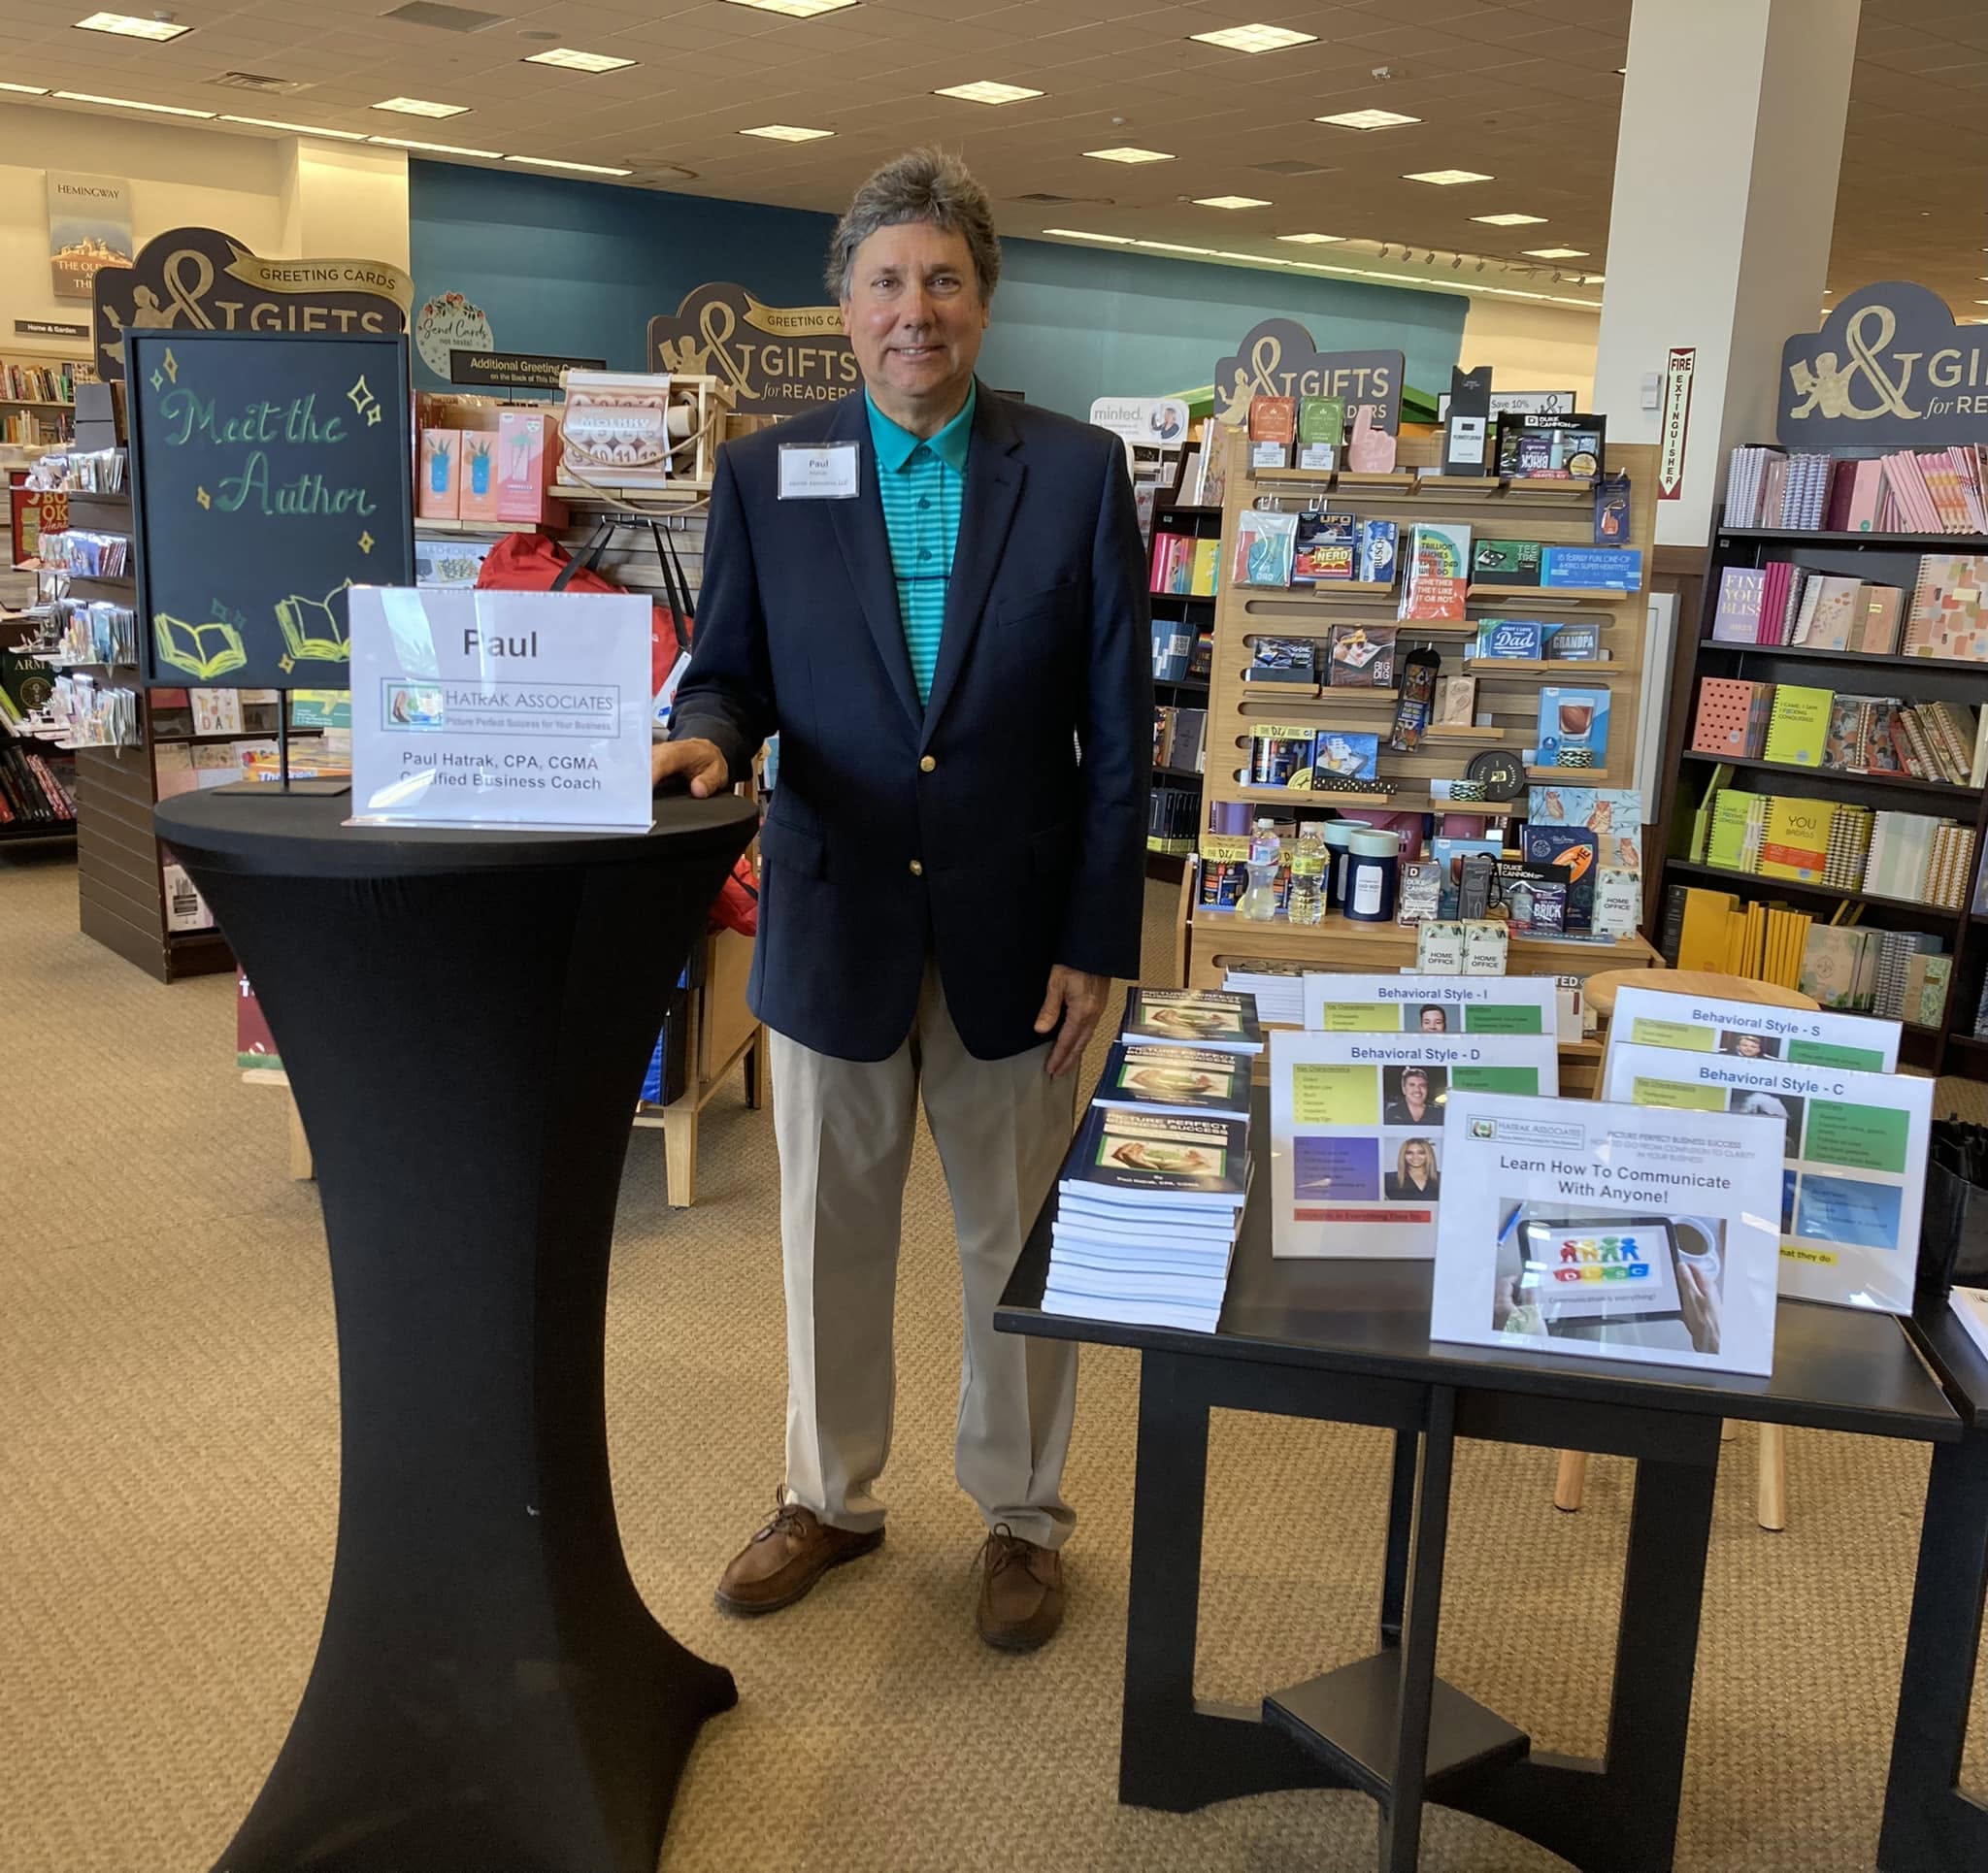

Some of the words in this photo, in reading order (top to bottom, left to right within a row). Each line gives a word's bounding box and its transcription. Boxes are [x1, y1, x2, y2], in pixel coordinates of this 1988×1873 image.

[57, 184, 119, 199] HEMINGWAY
[58, 260, 78, 271] THE
[260, 268, 339, 281] GREETING
[344, 270, 396, 290] CARDS
[423, 318, 452, 340] Send
[455, 319, 488, 340] Cards
[768, 315, 823, 327] GREETING
[471, 357, 517, 373] Additional
[520, 361, 560, 375] Greeting
[760, 345, 857, 381] GIFTS
[1671, 358, 1691, 372] FIRE
[761, 382, 779, 400] for
[1300, 368, 1390, 399] GIFTS
[1491, 401, 1509, 411] Save
[1923, 396, 1954, 419] for
[160, 389, 279, 444] Meet
[284, 392, 348, 443] the
[1665, 375, 1684, 484] EXTINGUISHER
[809, 459, 829, 468] Paul
[215, 446, 378, 516] Author
[1320, 515, 1350, 524] UFO
[1316, 551, 1349, 563] NERD
[1374, 537, 1384, 569] BUSCH
[464, 629, 537, 658] Paul
[1494, 632, 1535, 647] Dad
[1554, 636, 1595, 648] GRANDPA
[1374, 661, 1391, 671] BIG
[1373, 671, 1390, 679] DIG
[447, 691, 510, 706] HATRAK
[514, 693, 613, 710] ASSOCIATES
[403, 751, 437, 765] Paul
[443, 753, 498, 769] Hatrak,
[504, 755, 543, 771] CPA,
[547, 756, 599, 771] CGMA
[473, 773, 546, 788] Business
[550, 776, 602, 790] Coach
[1788, 815, 1816, 830] YOU
[1534, 904, 1562, 919] BRICK
[1378, 987, 1441, 999] Behavioral
[1444, 989, 1474, 1001] Style
[1692, 1008, 1763, 1029] Behavioral
[1766, 1019, 1799, 1035] Style
[1810, 1026, 1821, 1036] S
[1351, 1046, 1422, 1060] Behavioral
[1425, 1048, 1459, 1062] Style
[1471, 1049, 1480, 1060] D
[1700, 1067, 1778, 1088] Behavioral
[1781, 1076, 1819, 1093] Style
[1833, 1083, 1844, 1096] C
[1167, 1118, 1229, 1130] PERFECT
[1500, 1155, 1546, 1172] Learn
[1550, 1160, 1587, 1175] How
[1592, 1164, 1612, 1178] To
[1617, 1166, 1732, 1190] Communicate
[1558, 1180, 1596, 1197] With
[1600, 1185, 1669, 1203] Anyone!
[1798, 1251, 1817, 1263] they
[1818, 1254, 1832, 1263] do
